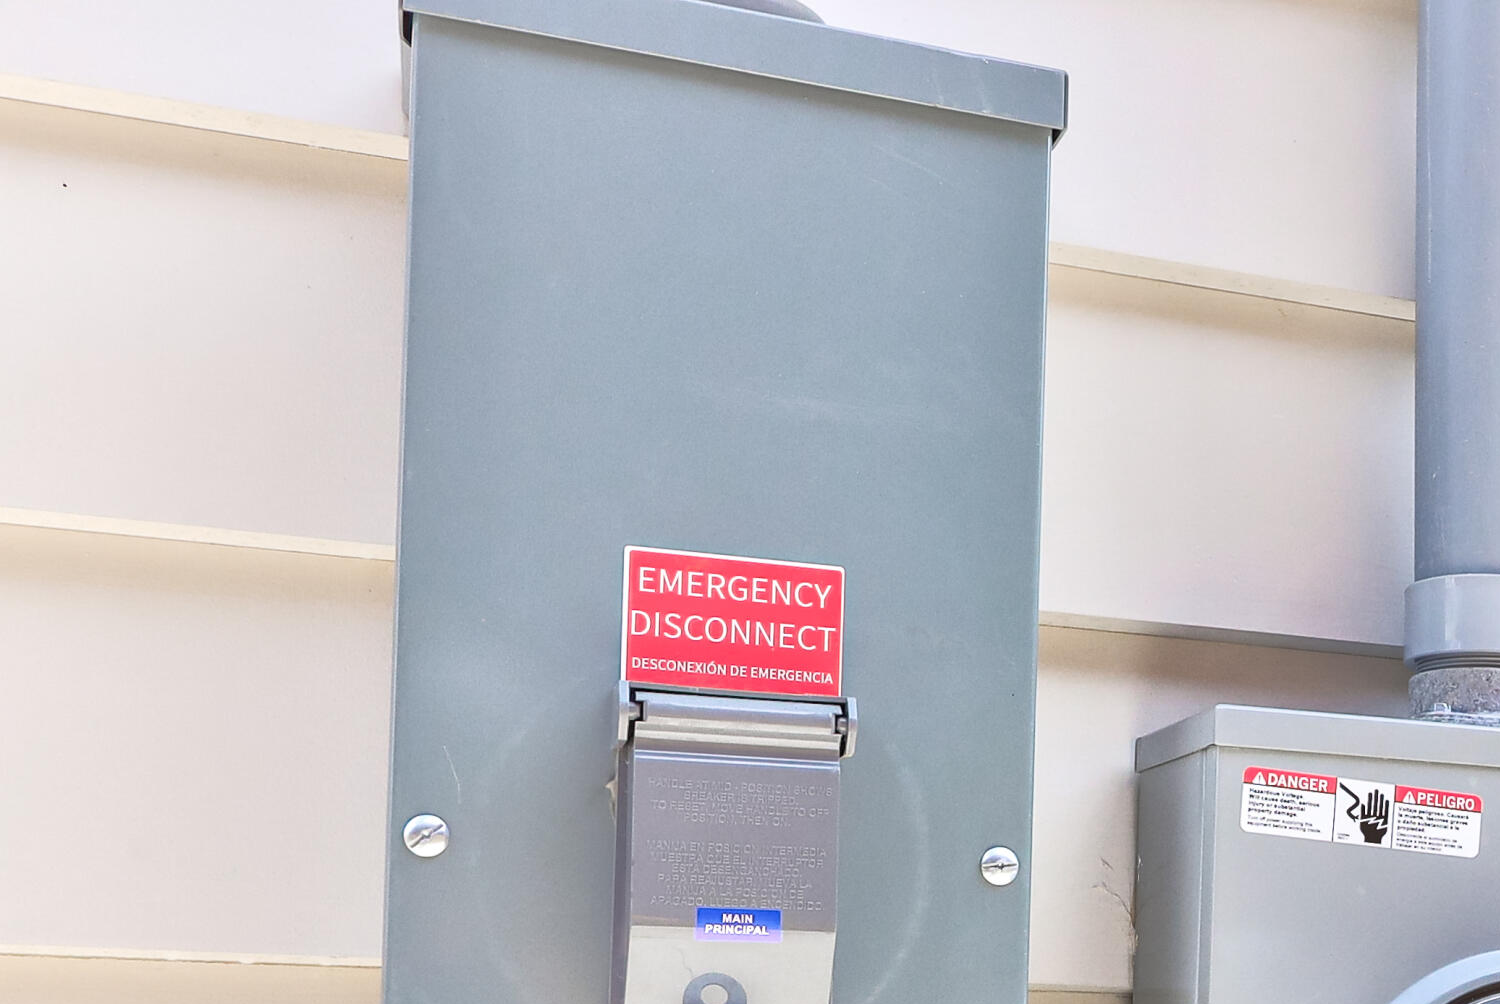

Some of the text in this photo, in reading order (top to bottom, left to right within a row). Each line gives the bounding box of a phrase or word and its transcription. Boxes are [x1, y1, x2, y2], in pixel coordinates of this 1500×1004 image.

[639, 566, 831, 608] EMERGENCY
[631, 610, 835, 651] DISCONNECT
[632, 657, 833, 684] DESCONEXIÓN DE EMERGENCIA
[1268, 773, 1328, 792] DANGER
[685, 790, 735, 802] BREAKER
[1250, 788, 1280, 796] Hazardous
[650, 800, 666, 809] TO
[748, 807, 788, 816] HANDLE
[792, 808, 806, 817] TO
[810, 808, 829, 817] OFF
[1417, 792, 1475, 810] PELIGRO
[722, 914, 752, 923] MAIN
[705, 924, 769, 935] PRINCIPAL
